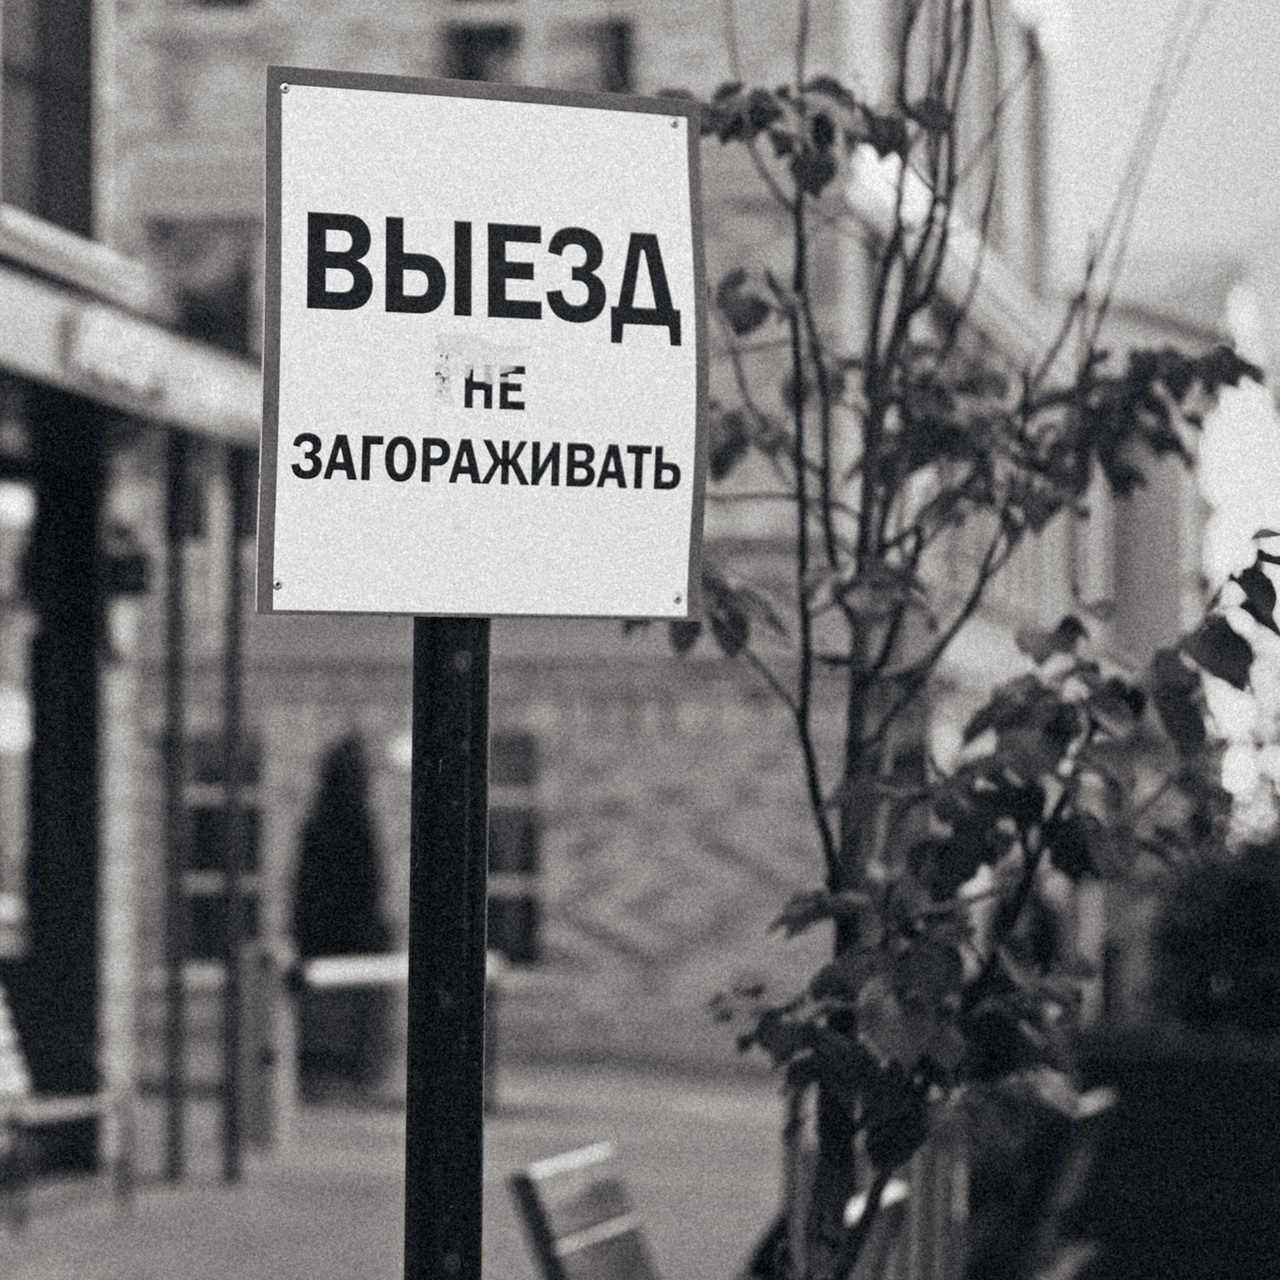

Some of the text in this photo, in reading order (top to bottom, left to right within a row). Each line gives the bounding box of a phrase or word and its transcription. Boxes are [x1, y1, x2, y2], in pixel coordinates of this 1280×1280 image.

[306, 211, 682, 347] ВЫЕЗД
[464, 365, 526, 410] НЕ
[291, 432, 681, 490] ЗАГОРАЖИВАТЬ
